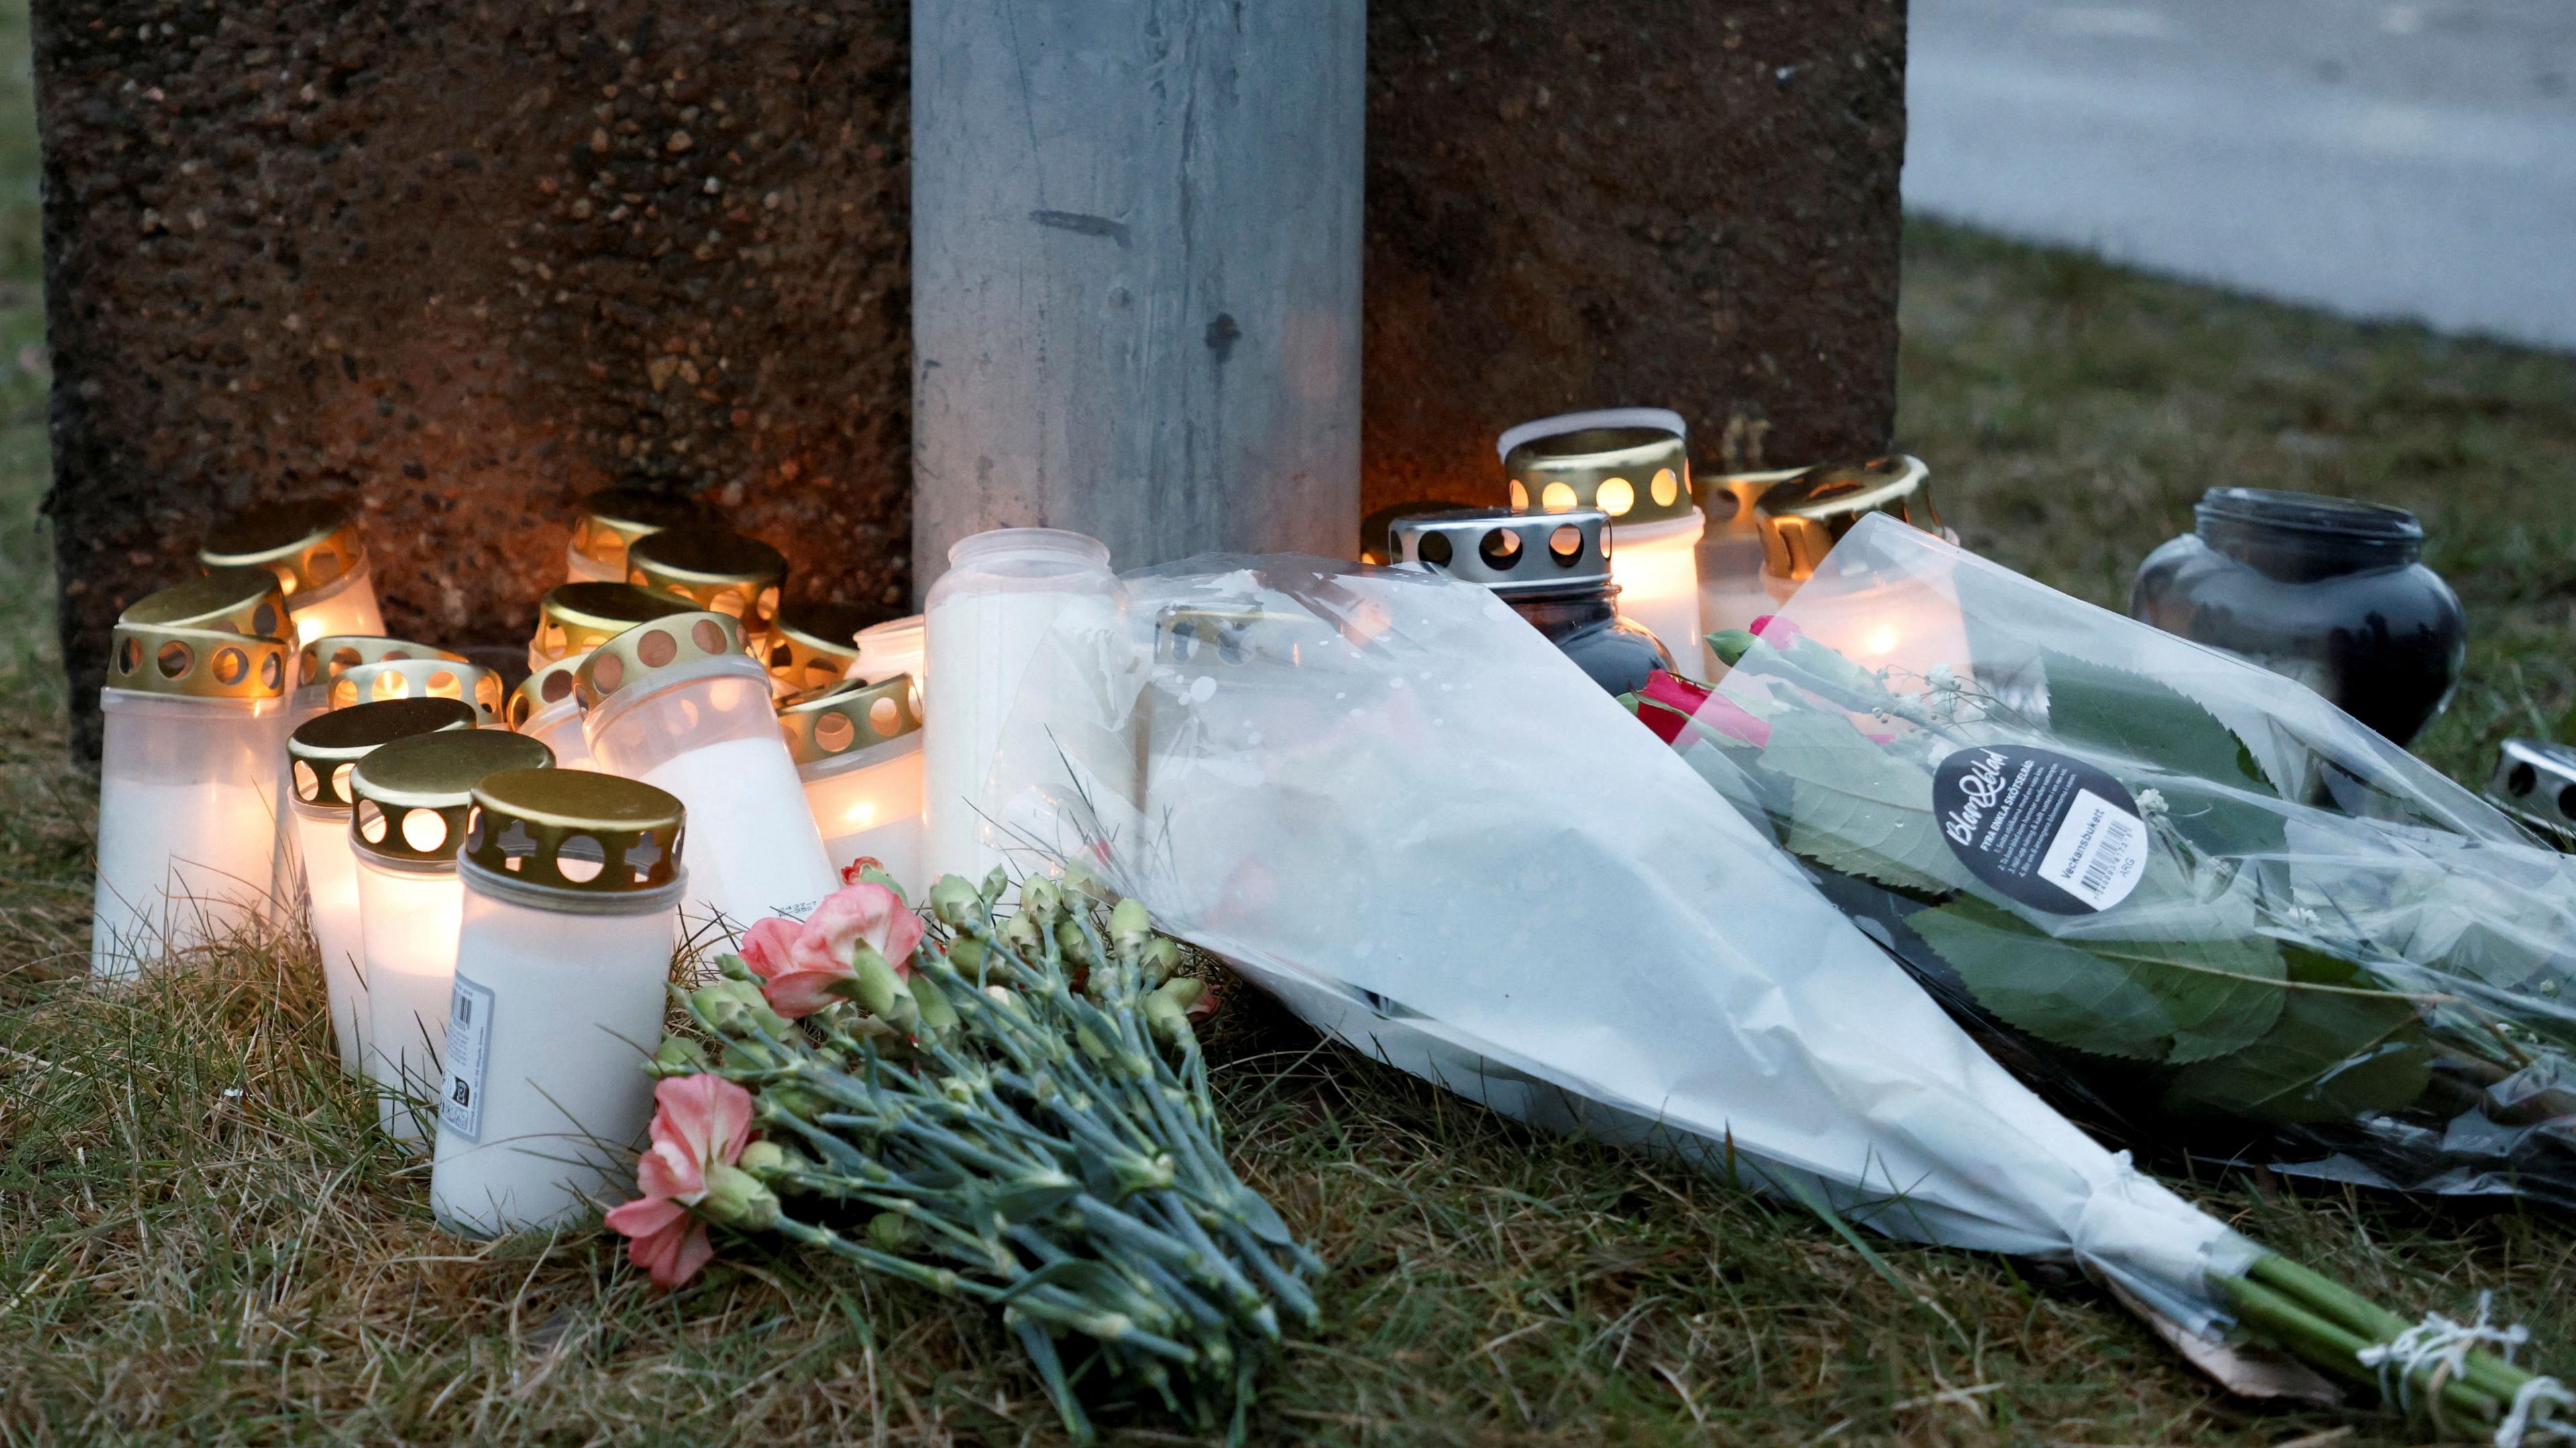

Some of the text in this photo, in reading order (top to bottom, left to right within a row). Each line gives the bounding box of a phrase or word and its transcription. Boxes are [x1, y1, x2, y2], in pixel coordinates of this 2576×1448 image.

[1945, 748, 2008, 846] Blom&blad
[1980, 759, 2034, 852] FYRA ENKLA SKÖTSELRÅD:
[2003, 846, 2015, 859] bort
[2010, 834, 2021, 848] blad
[2022, 802, 2037, 824] hamnar
[2035, 785, 2046, 803] under
[2019, 794, 2029, 809] med
[2030, 776, 2039, 787] vass
[2023, 830, 2037, 848] näring
[2033, 812, 2044, 825] kallt
[2041, 794, 2053, 812] vatten
[2034, 822, 2051, 849] arrangera
[2047, 791, 2068, 822] blommorna
[2061, 808, 2104, 879] Veckansbukett
[2119, 857, 2135, 878] ARG
